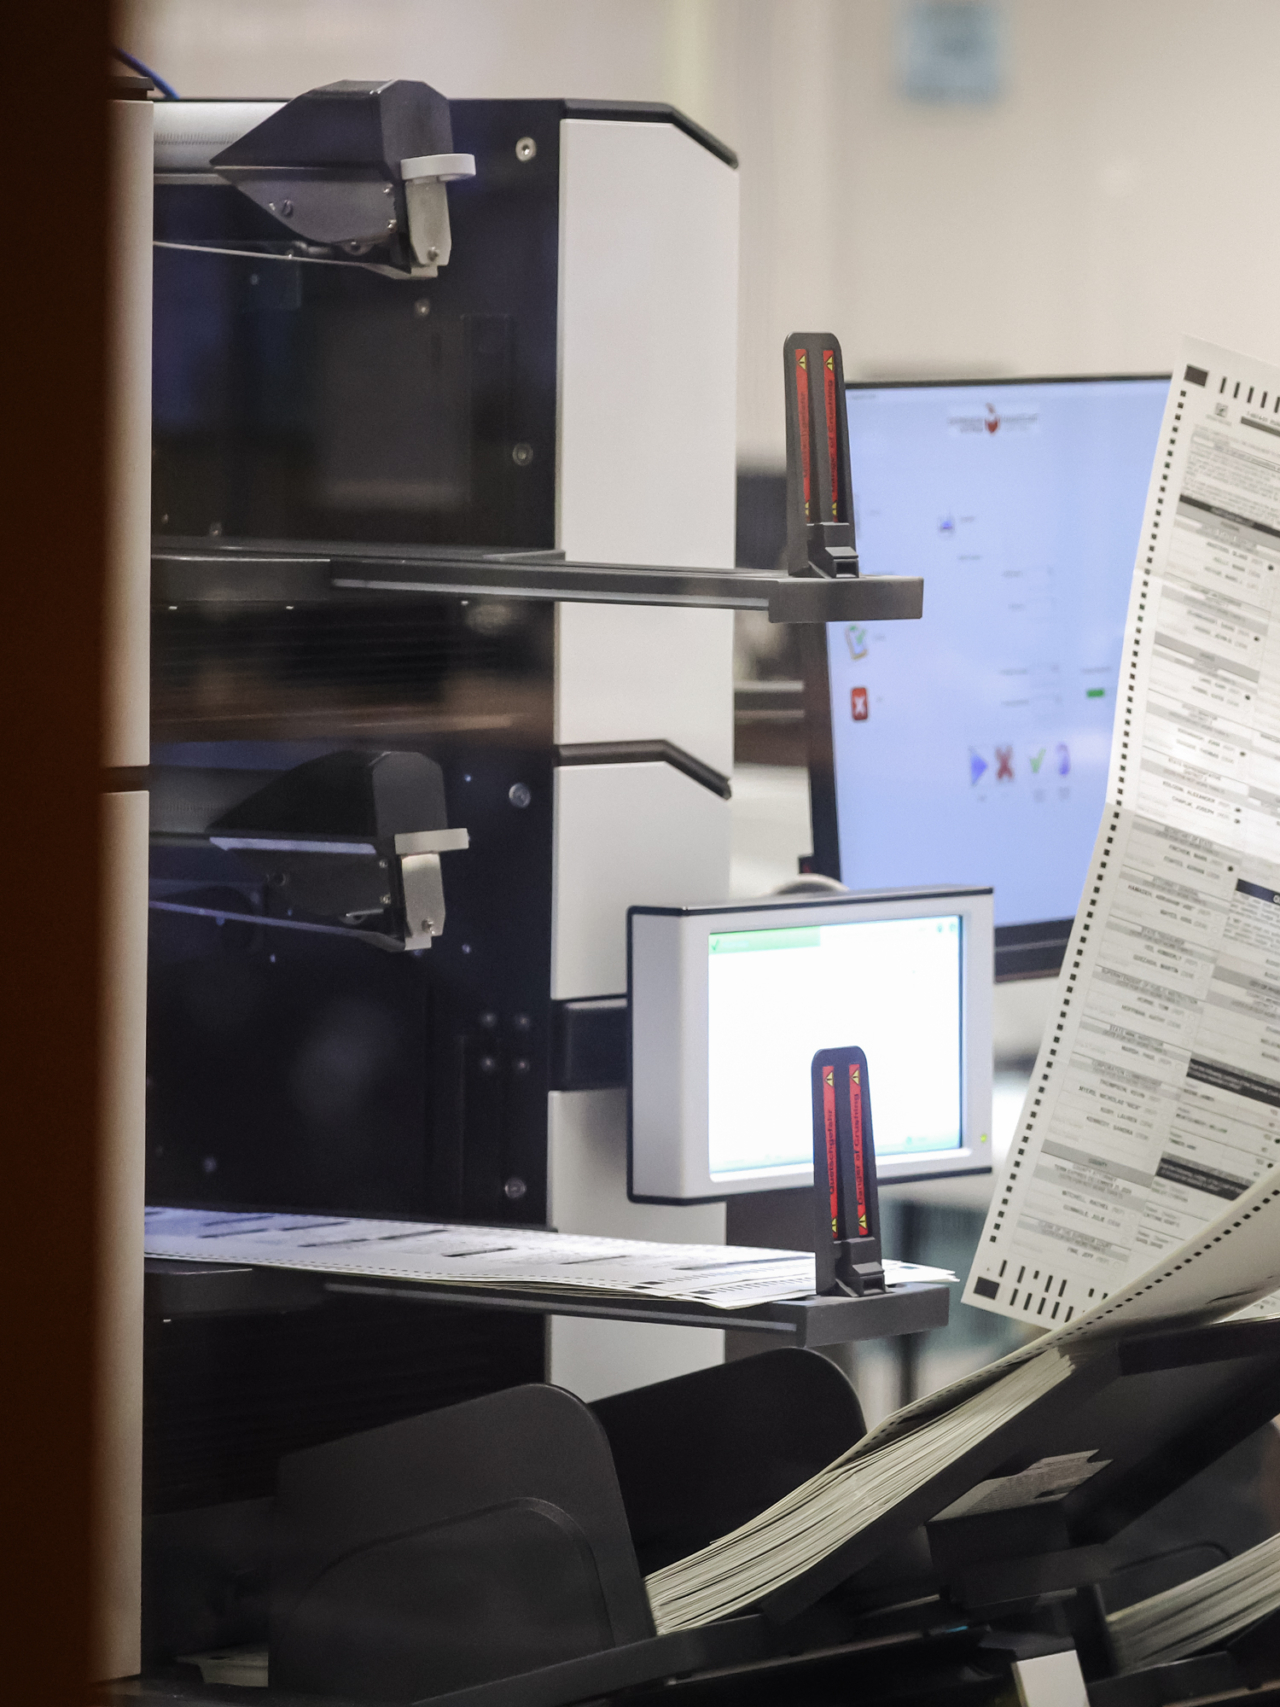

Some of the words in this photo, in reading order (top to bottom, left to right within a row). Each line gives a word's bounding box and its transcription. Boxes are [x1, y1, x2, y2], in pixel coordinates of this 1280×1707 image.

[853, 1094, 861, 1146] Crushing
[827, 1110, 835, 1194] Quetschgefahr
[855, 1165, 864, 1205] Danger
